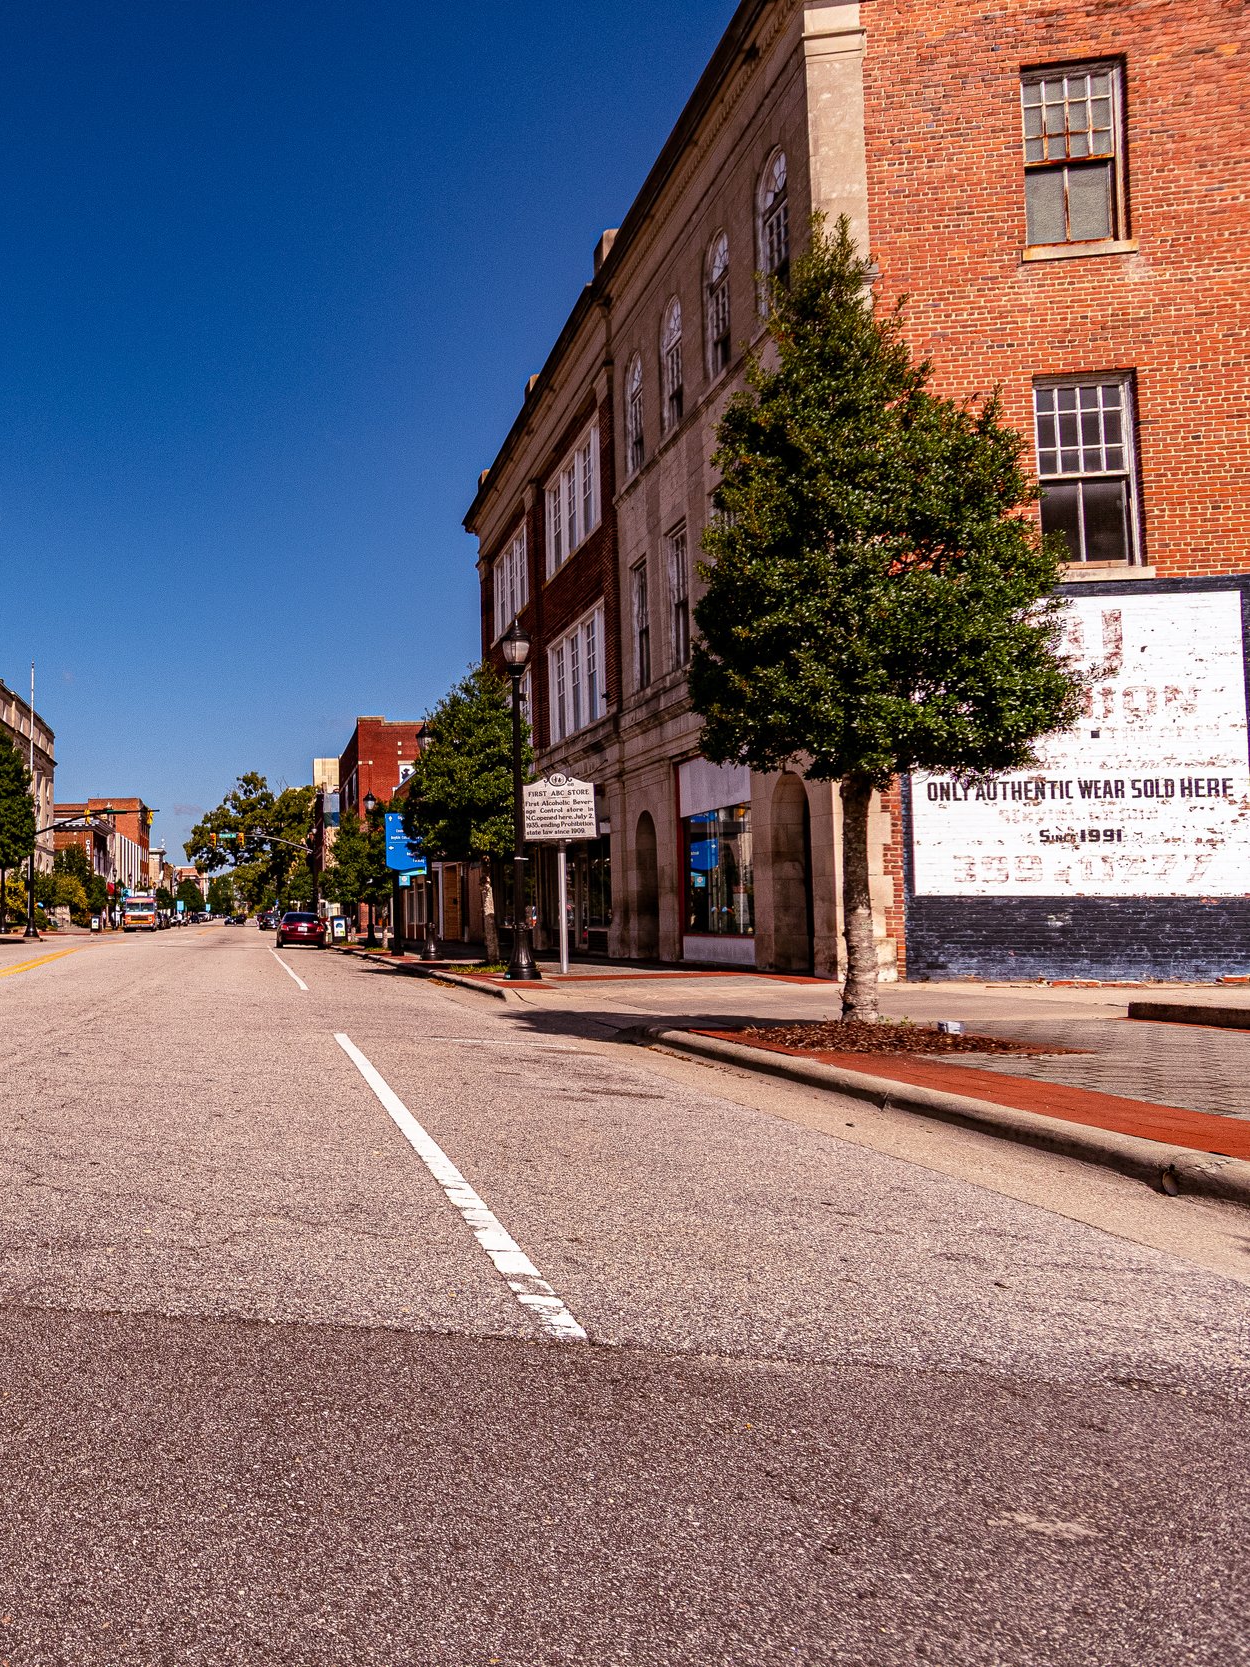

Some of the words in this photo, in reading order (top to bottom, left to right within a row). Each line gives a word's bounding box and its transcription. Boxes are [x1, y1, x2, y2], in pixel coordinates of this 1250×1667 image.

[528, 790, 547, 798] FIRST
[550, 789, 565, 797] ABC
[927, 781, 969, 801] ONLY
[975, 779, 1074, 801] AUTHENTIC
[1077, 778, 1126, 799] WEAR
[1131, 777, 1176, 799] SOLD
[1180, 776, 1234, 798] HERE
[1080, 828, 1122, 843] 1991
